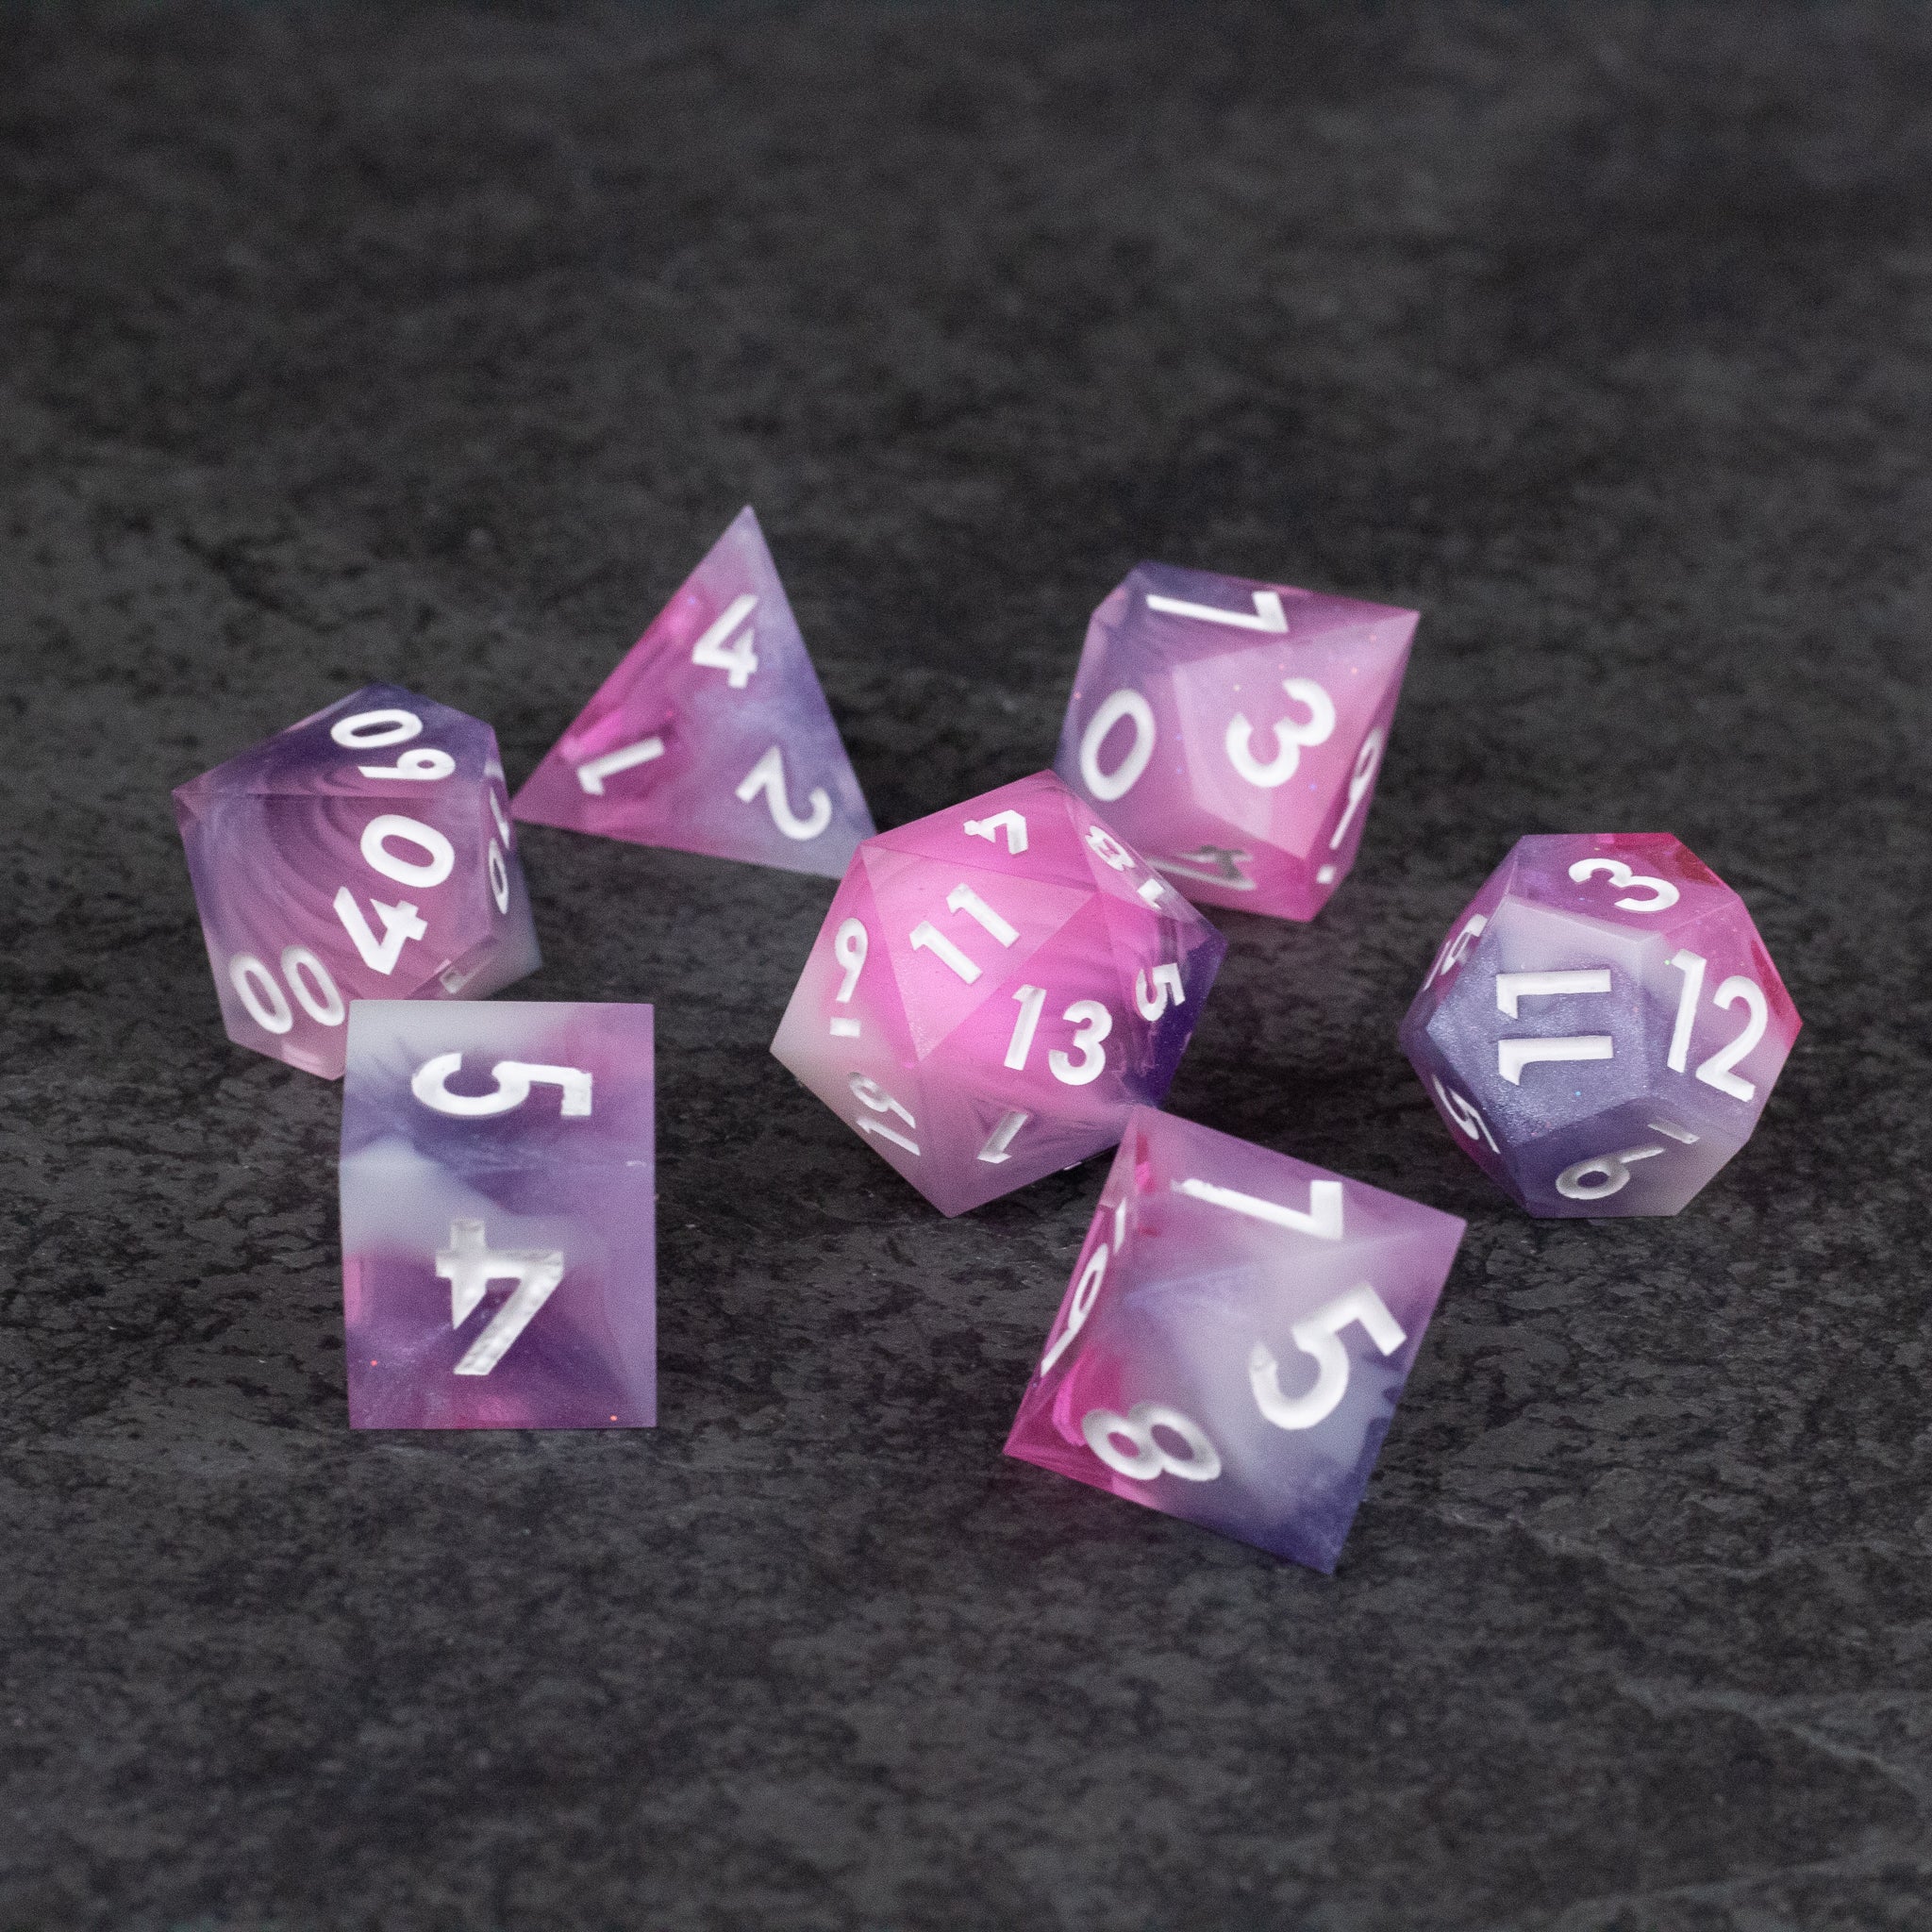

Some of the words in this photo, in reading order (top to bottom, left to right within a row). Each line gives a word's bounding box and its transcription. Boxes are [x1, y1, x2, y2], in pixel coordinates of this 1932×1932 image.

[691, 593, 758, 690] 4
[1145, 590, 1290, 635] 7
[575, 737, 665, 796] 1
[1080, 688, 1156, 802] 0
[1224, 677, 1337, 789] 3
[735, 745, 832, 841] 2
[332, 814, 456, 975] 40
[1568, 858, 1680, 912] 3
[909, 883, 1021, 986] 11
[229, 945, 346, 1035] 00
[1003, 983, 1113, 1086] 13
[1135, 962, 1186, 1023] 5
[1495, 968, 1614, 1087] 11
[1667, 948, 1769, 1103] 12
[410, 1051, 592, 1117] 5
[848, 1072, 921, 1157] 19
[1432, 1074, 1502, 1155] 5
[1171, 1178, 1344, 1240] 7
[435, 1218, 564, 1376] 4
[1248, 1281, 1407, 1431] 5
[1081, 1401, 1223, 1482] 8
